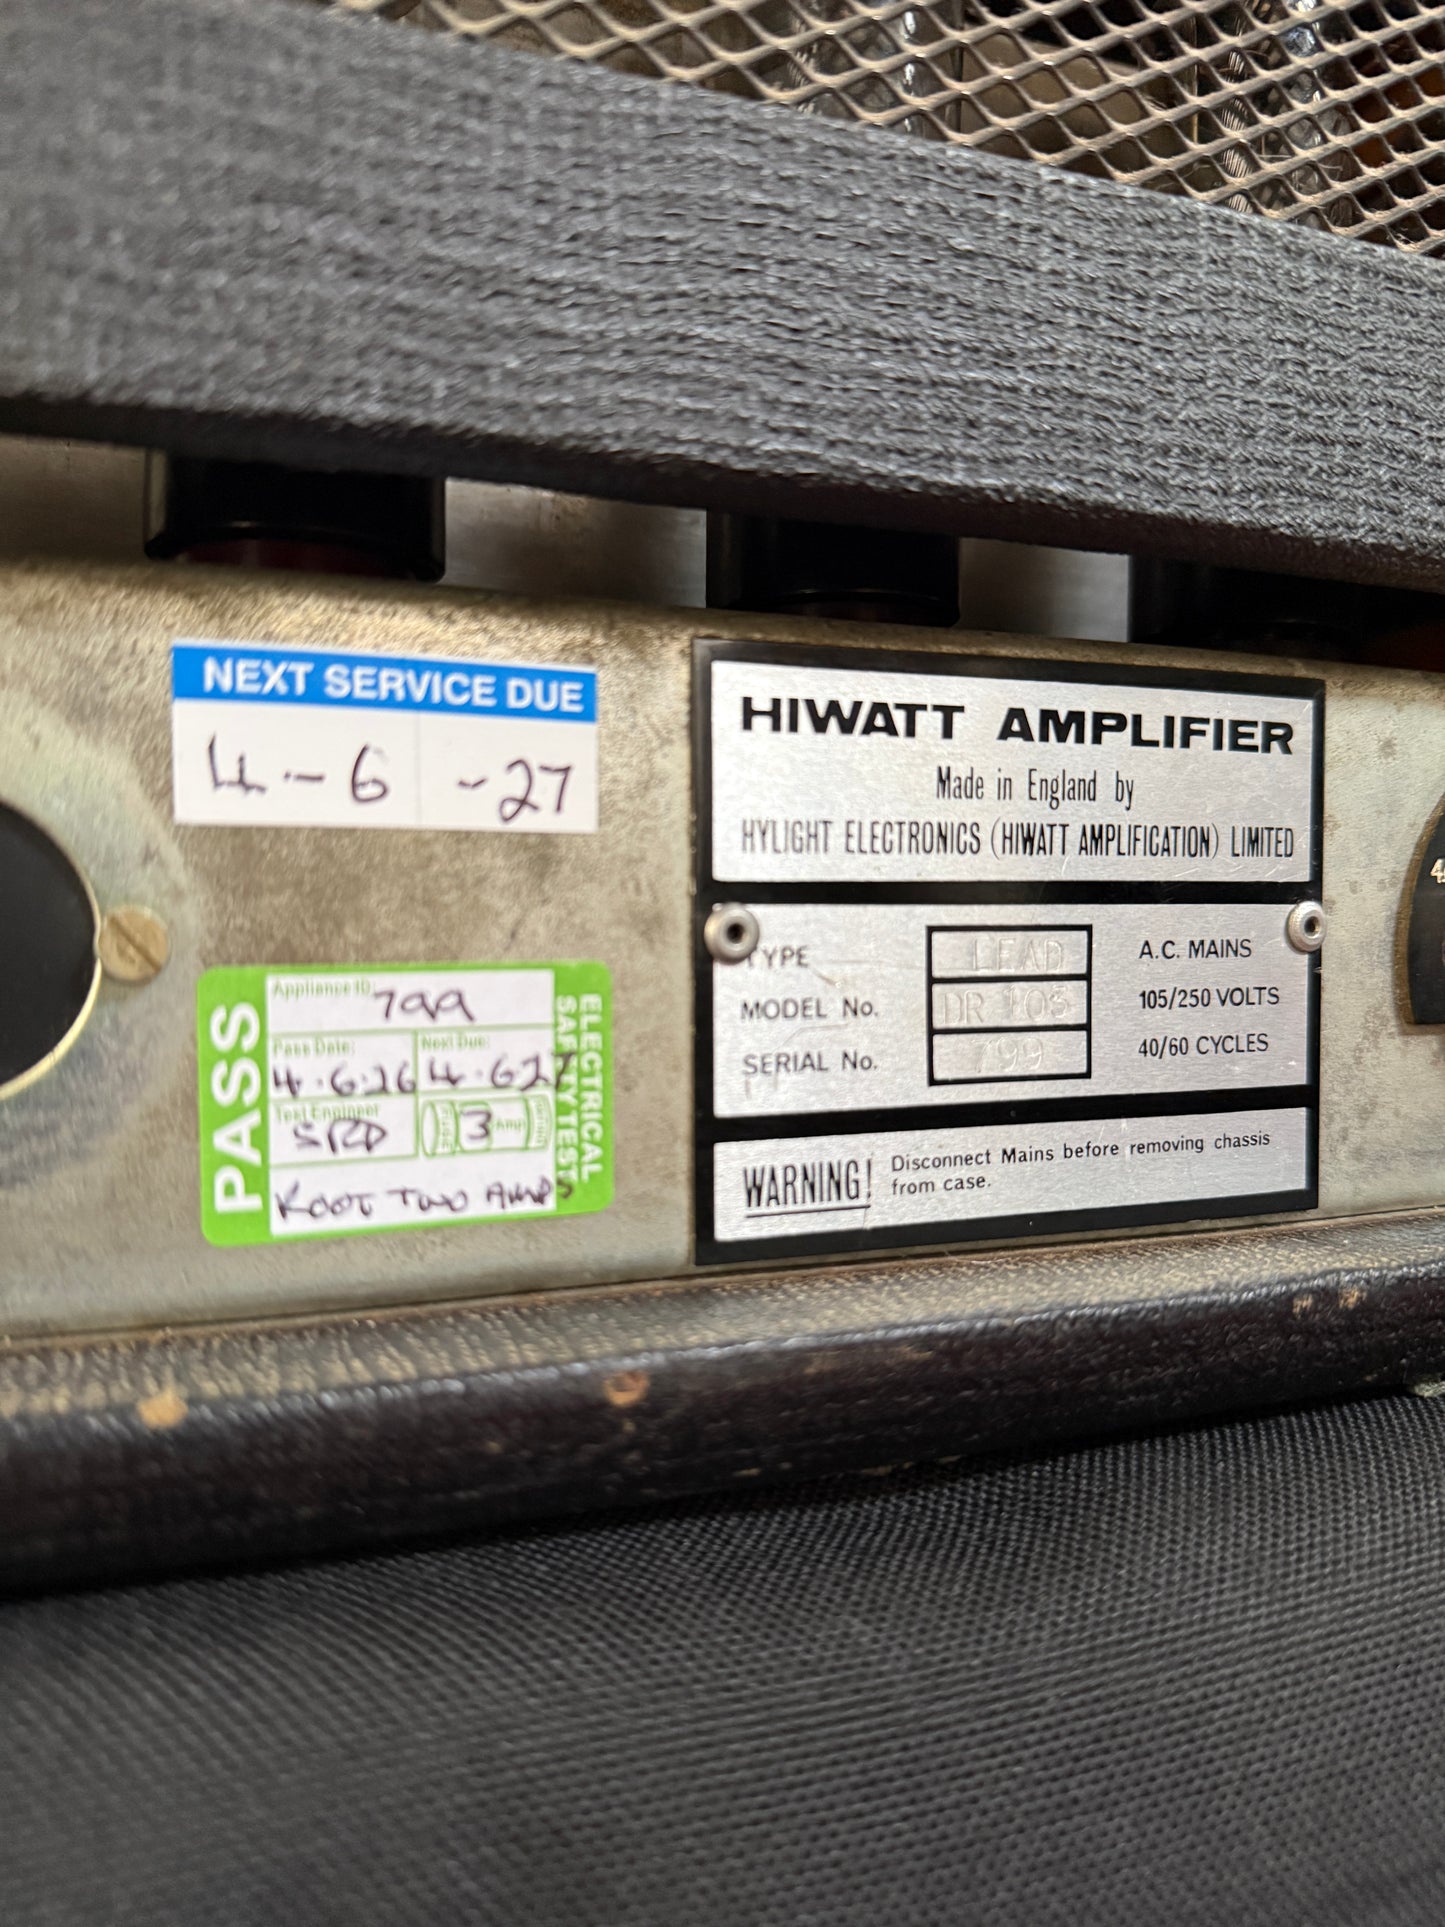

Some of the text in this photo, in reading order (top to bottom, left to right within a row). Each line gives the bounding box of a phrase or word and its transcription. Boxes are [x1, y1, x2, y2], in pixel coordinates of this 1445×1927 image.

[203, 655, 585, 713] NEXT SERVICE DUE
[742, 696, 1294, 755] HIWATT AMPLIFIER
[936, 765, 1134, 811] Made in England by
[742, 815, 1295, 860] HYLIGHT ELECTRONICS (HIWATT AMPLIFICATION) LIMITED
[972, 937, 1063, 973] LEAD
[1138, 937, 1252, 960] A.C. MAINS
[273, 980, 350, 1001] Appliance
[942, 989, 985, 1024] DR
[1138, 986, 1281, 1011] 105/250 VOLTS
[740, 996, 879, 1021] MODEL No.
[273, 1039, 311, 1056] Pass
[421, 1036, 453, 1051] Next
[1138, 1033, 1270, 1060] 40/60 CYCLES
[742, 1051, 878, 1076] SERIAL No.
[580, 994, 604, 1183] ELECTRICAL
[209, 1002, 263, 1214] PASS
[463, 1109, 492, 1140] 3
[556, 1109, 580, 1183] TEST
[891, 1130, 1271, 1172] Disconnect Mains before removing chassis
[743, 1159, 872, 1208] WARNING!
[892, 1174, 992, 1196] from case.
